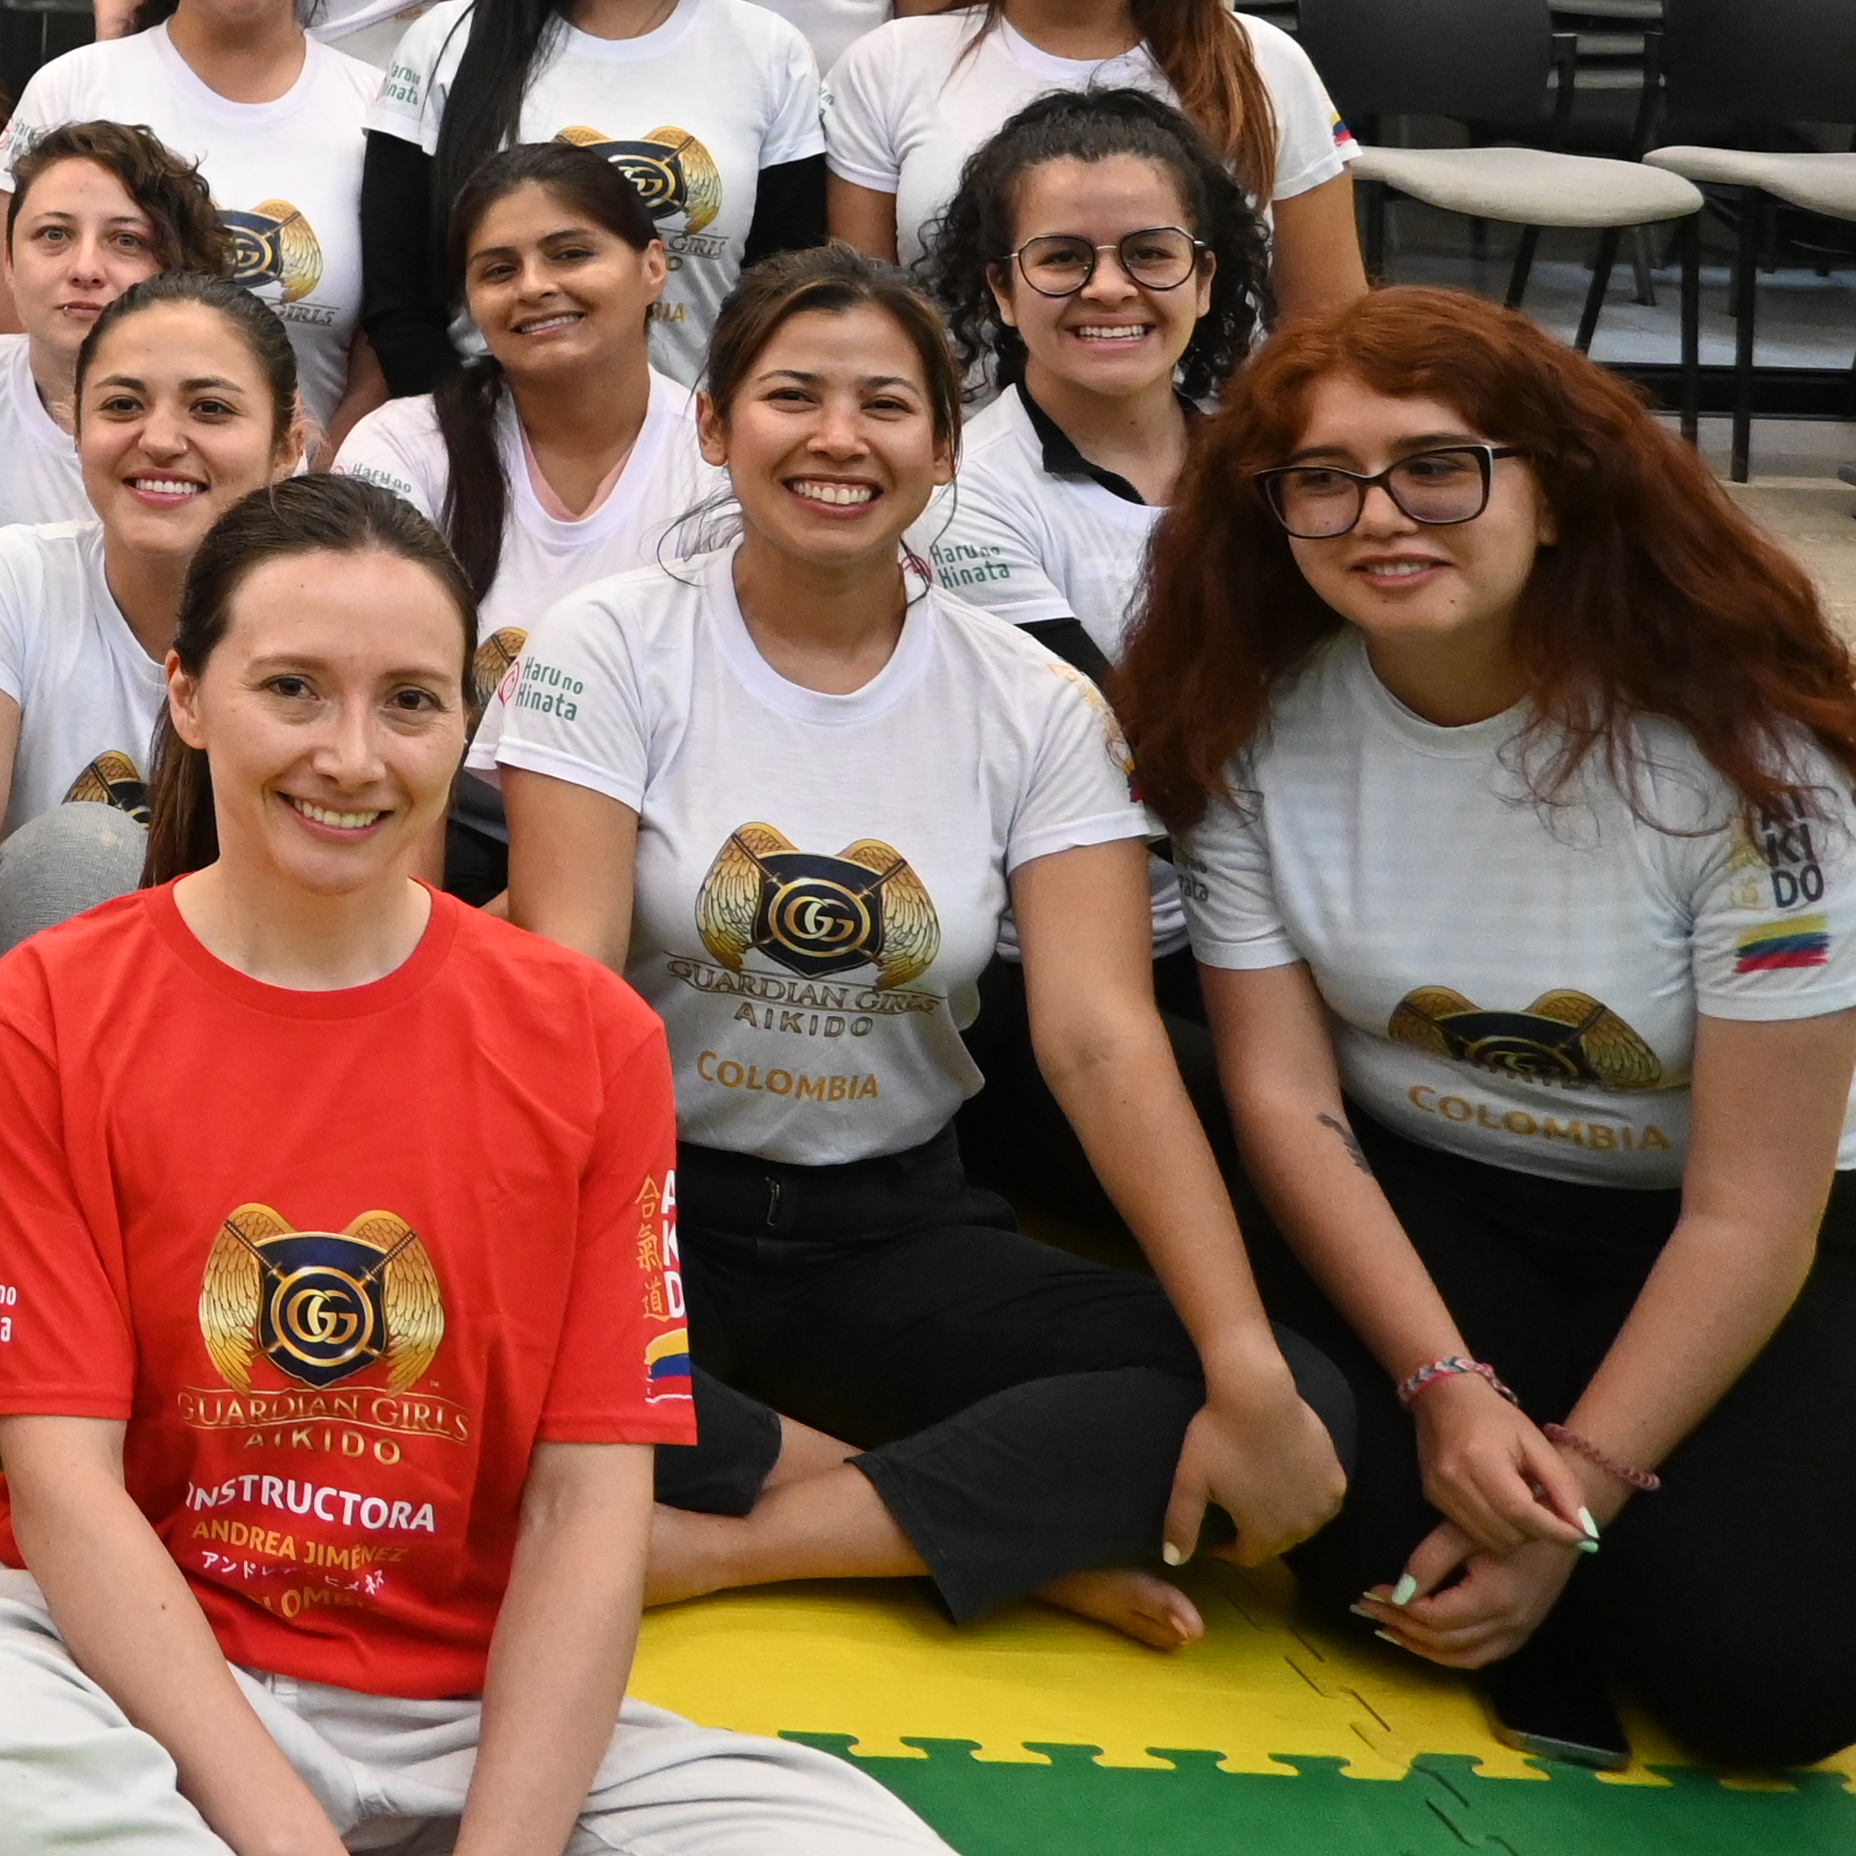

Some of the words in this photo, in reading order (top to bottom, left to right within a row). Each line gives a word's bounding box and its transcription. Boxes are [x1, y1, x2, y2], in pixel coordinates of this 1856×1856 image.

[938, 560, 1011, 590] Hinata
[522, 655, 584, 696] Haruno
[514, 681, 579, 722] Hinata
[1770, 864, 1825, 908] DO
[667, 959, 849, 1009] GUARDIAN
[734, 1001, 874, 1038] AIKIDO
[698, 1050, 879, 1102] COLOMBIA
[1408, 1085, 1673, 1152] COLOMBIA
[177, 1392, 359, 1427] GUARDIAN
[371, 1397, 470, 1442] GIRLS
[244, 1426, 402, 1466] AIKIDO
[185, 1474, 436, 1533] INSTRUCTORA
[192, 1518, 297, 1562] ANDREA
[303, 1539, 410, 1571] JIMÉNEZ
